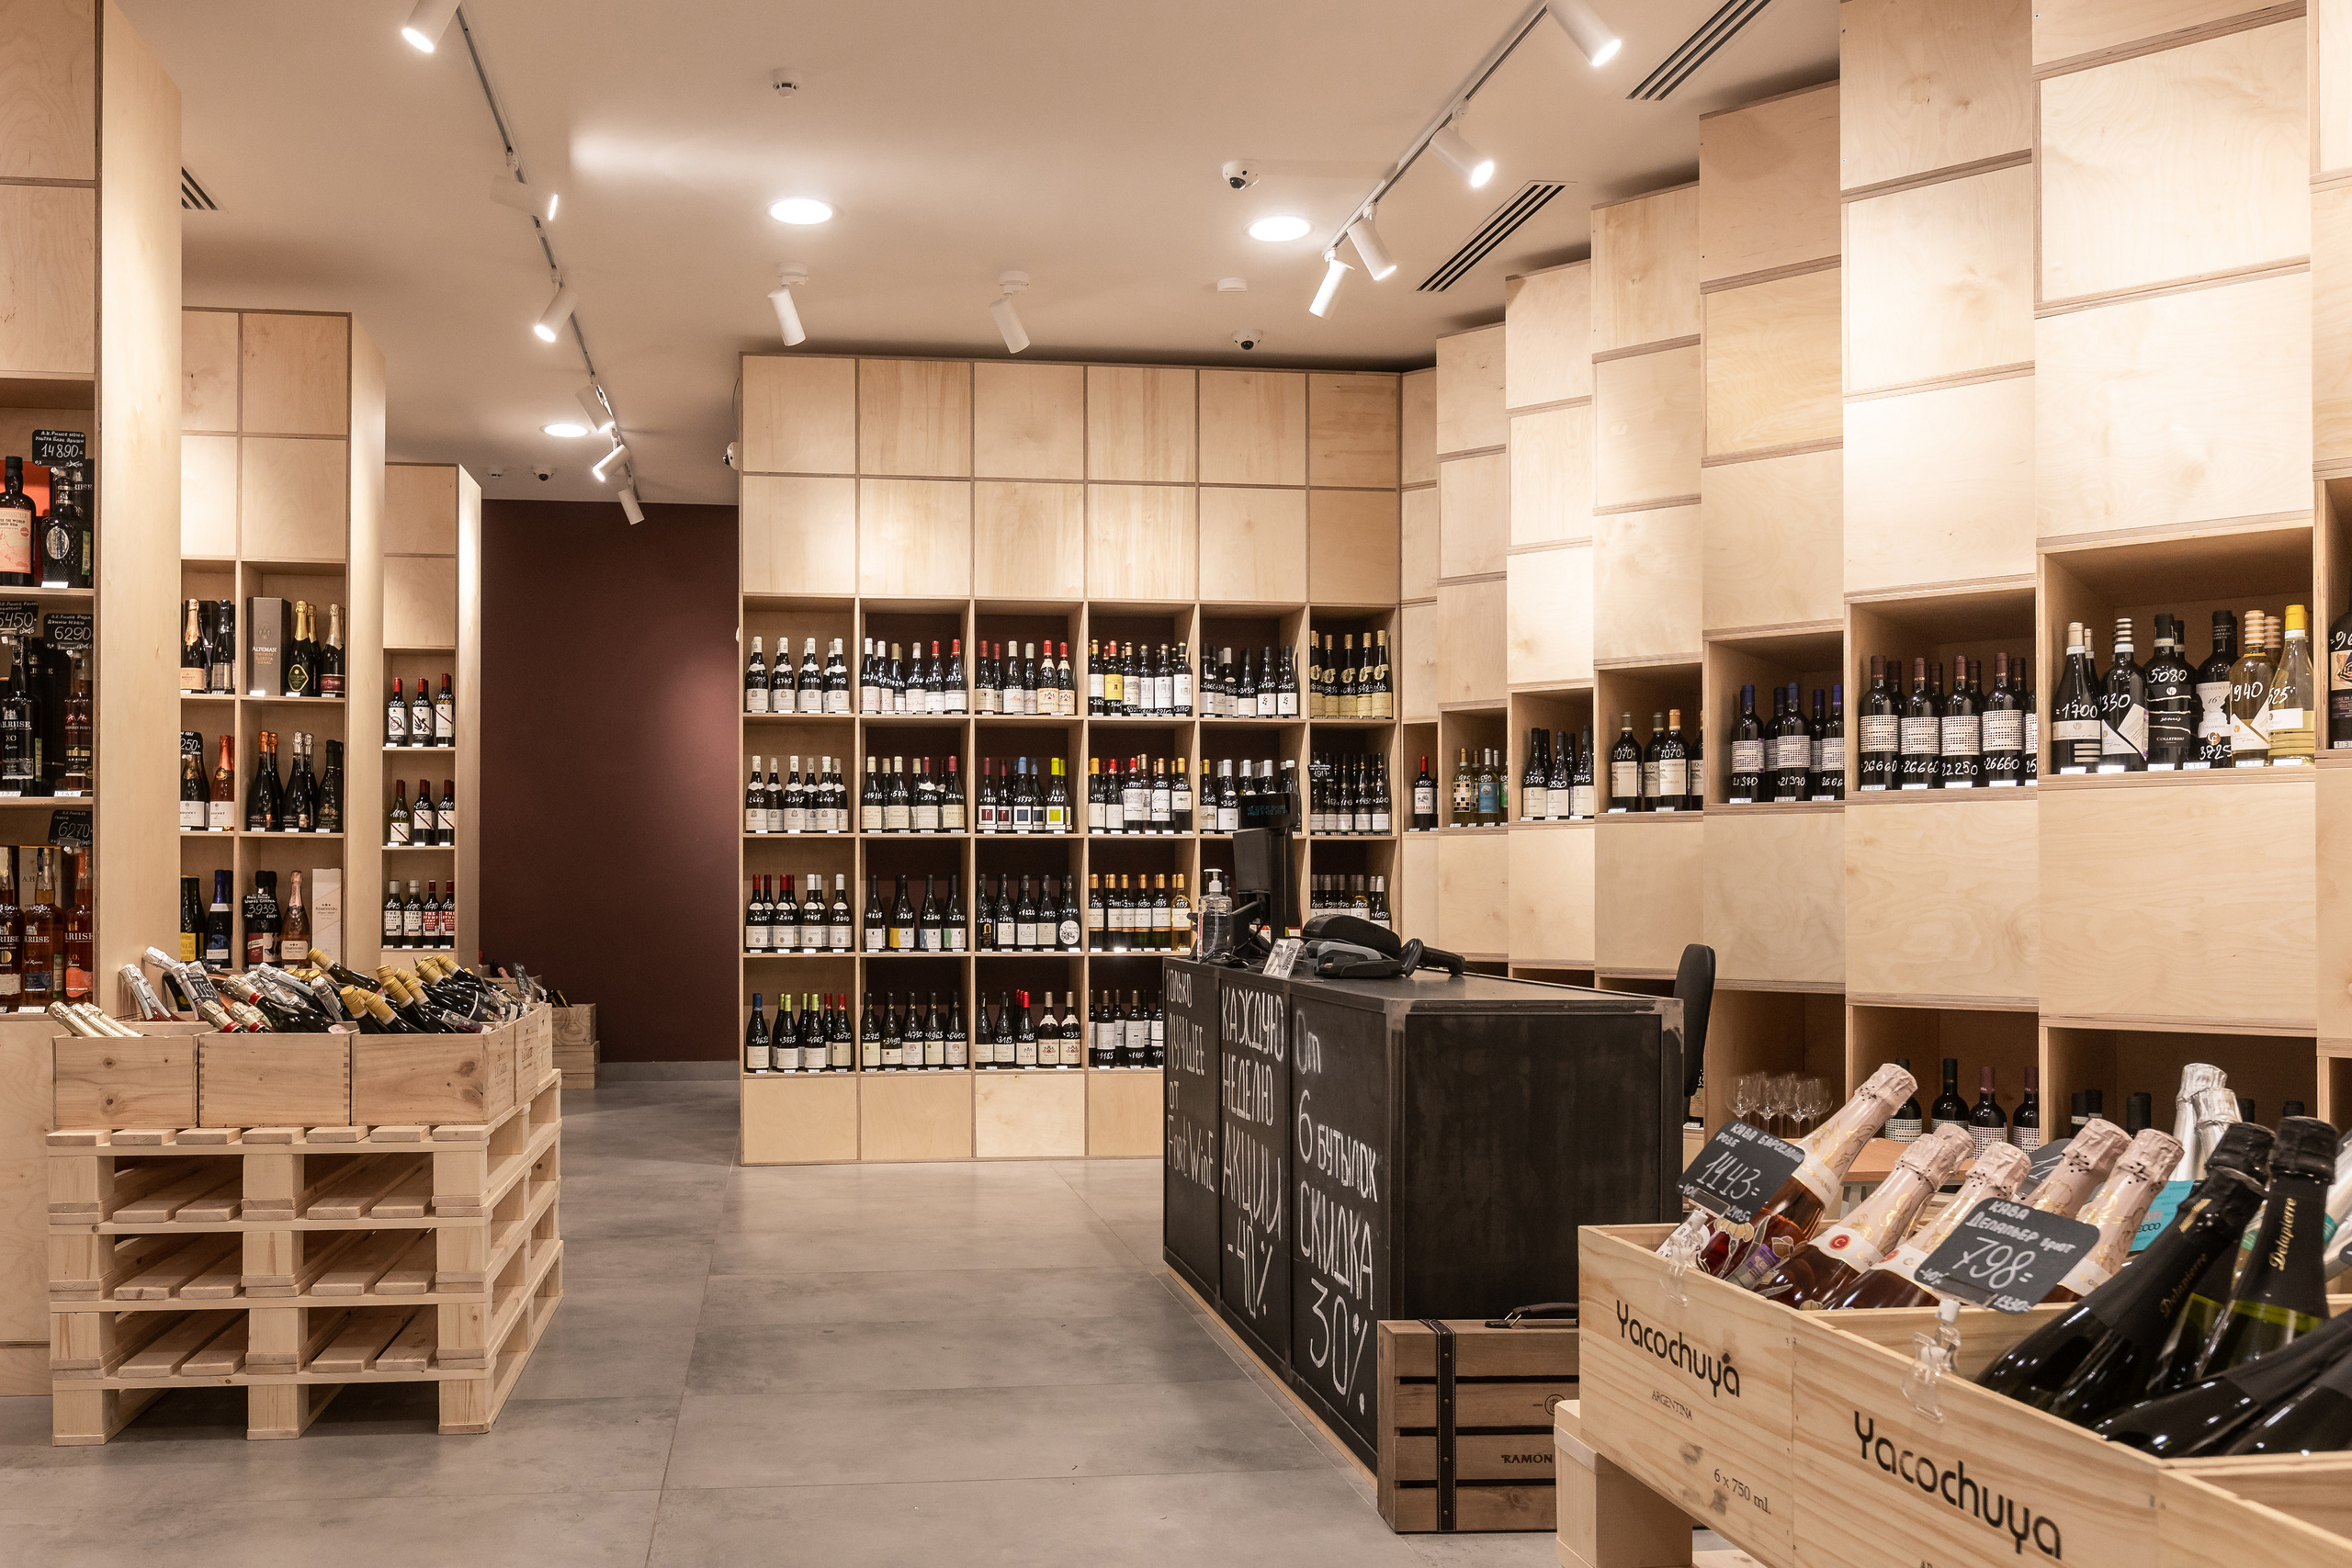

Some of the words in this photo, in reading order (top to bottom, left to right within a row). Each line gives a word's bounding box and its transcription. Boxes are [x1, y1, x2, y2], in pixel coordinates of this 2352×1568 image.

[2150, 667, 2187, 683] 5080
[248, 903, 276, 916] 3939
[1168, 1013, 1204, 1076] ЛУЧШЕЕ
[1222, 987, 1284, 1062] КАЖДУЮ
[1223, 1053, 1273, 1126] НЕДЕЛЮ
[1298, 1089, 1313, 1164] 6
[1317, 1123, 1378, 1202] БУТЫЛОК
[1715, 1132, 1741, 1148] РОЗЕ
[1730, 1122, 1758, 1142] КАВА
[1223, 1122, 1282, 1240] АКЦИИ
[1987, 1200, 2030, 1221] КАВА
[1300, 1180, 1374, 1311] СКИДКА
[2268, 1197, 2298, 1271] Delapierre
[1309, 1278, 1369, 1416] 30%
[1616, 1300, 1740, 1398] Yacochuya
[1651, 1390, 1693, 1421] ARGENTINA
[1713, 1468, 1721, 1483] 6
[1732, 1477, 1751, 1501] 750
[1753, 1494, 1771, 1515] ml.
[1854, 1410, 2062, 1561] Yacochuya
